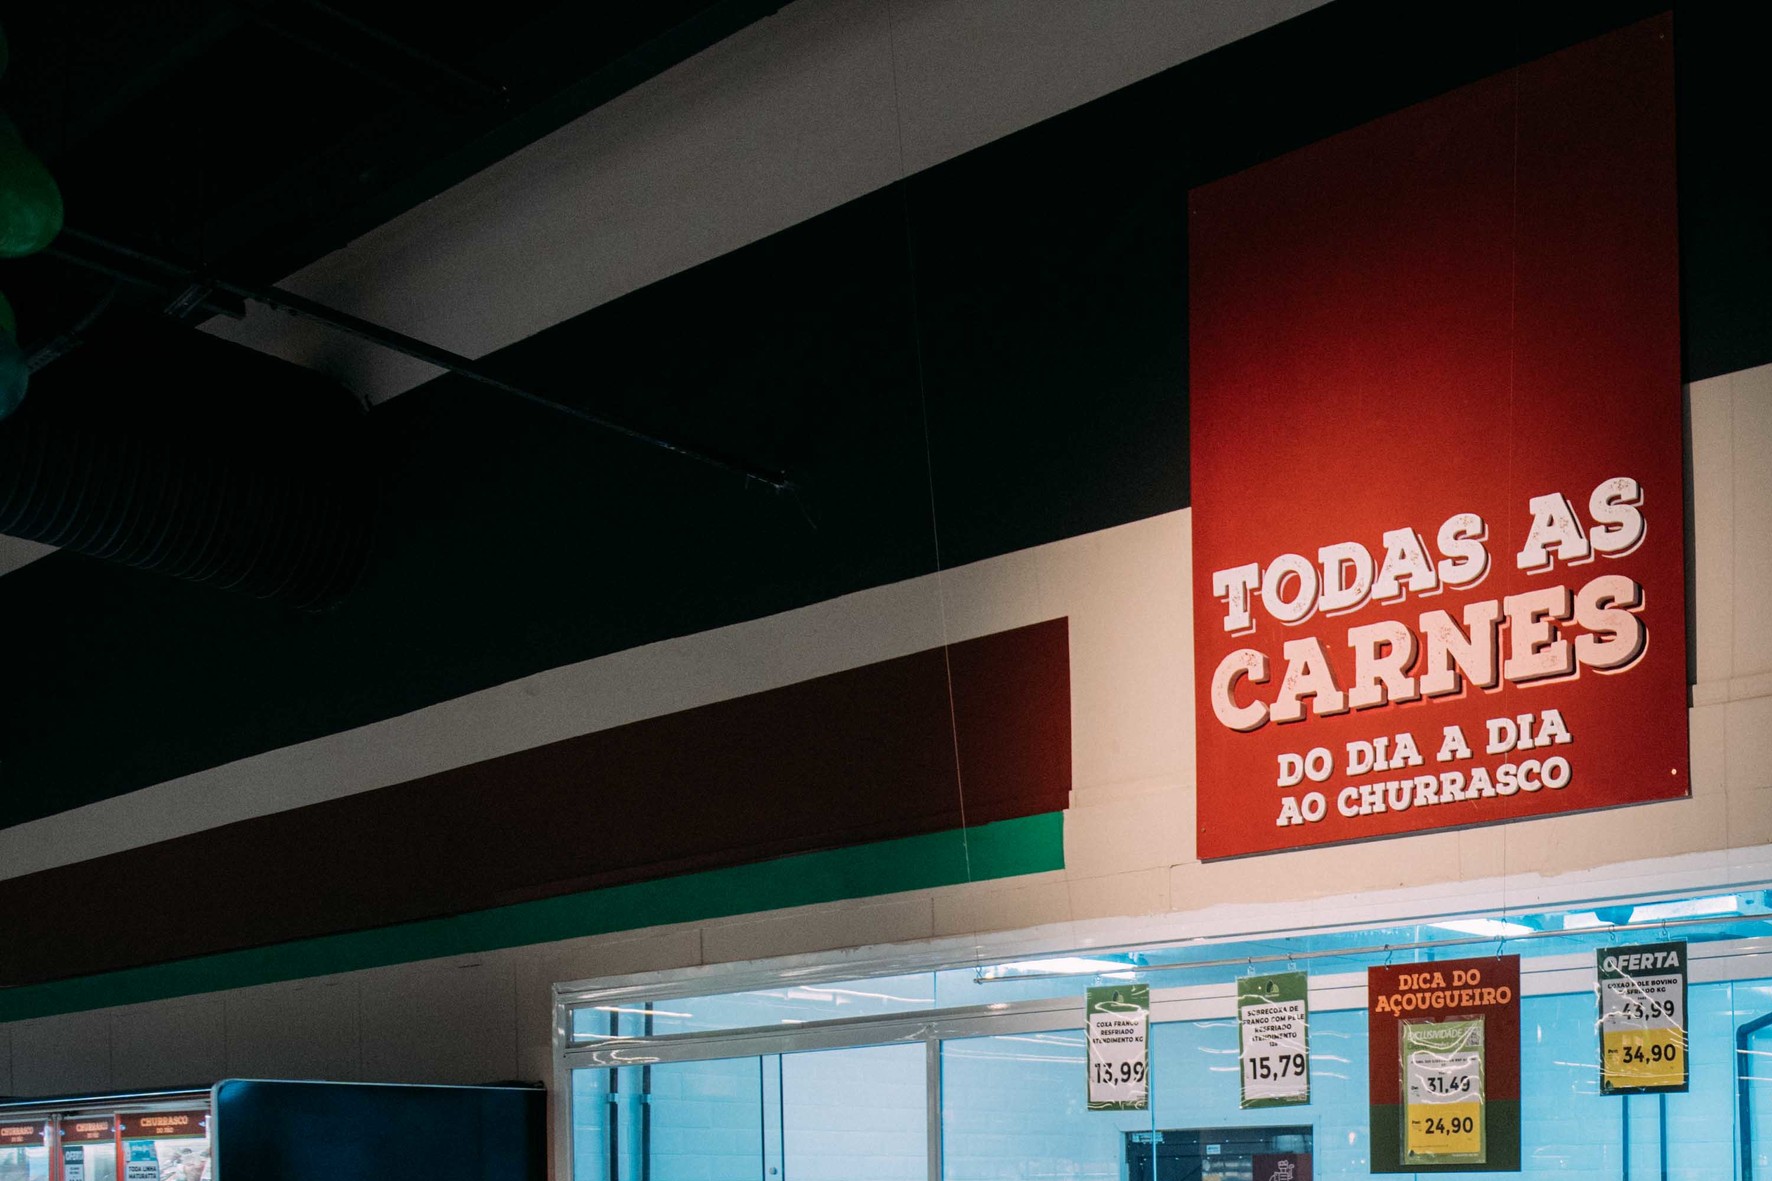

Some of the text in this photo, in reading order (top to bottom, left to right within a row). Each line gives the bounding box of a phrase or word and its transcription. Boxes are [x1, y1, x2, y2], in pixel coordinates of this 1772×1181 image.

[1212, 477, 1645, 635] TODAS AS
[1211, 575, 1648, 731] CARNES
[1277, 709, 1572, 787] DO DIA A DIA
[1276, 756, 1572, 826] AO CHURRASCO
[1603, 951, 1679, 972] OFERTA
[1399, 969, 1480, 990] DICA DO
[1375, 986, 1512, 1016] AÇOUGUEIRO
[1622, 1000, 1675, 1021] 43,99
[1101, 1028, 1134, 1036] RESFRIADO
[1623, 1043, 1676, 1064] 34,90
[1095, 1061, 1144, 1086] 13,99
[1250, 1054, 1305, 1081] 15,79
[141, 1115, 188, 1127] CHURRASCO
[1425, 1117, 1473, 1136] 24,90
